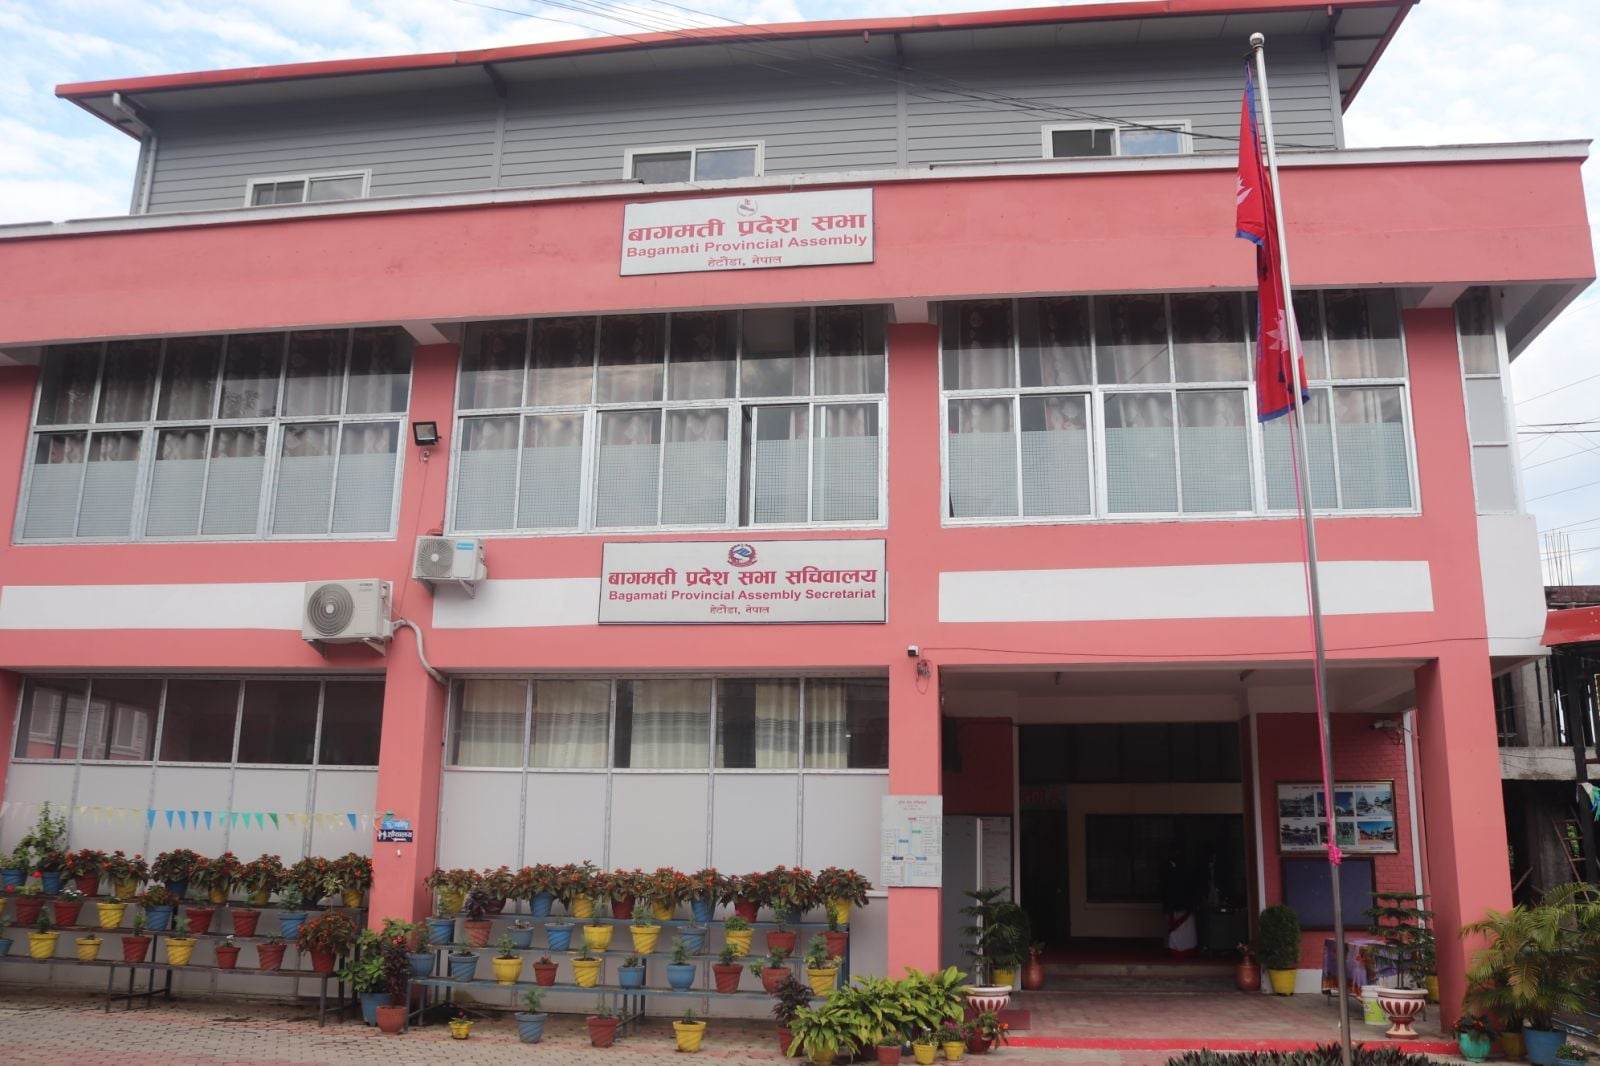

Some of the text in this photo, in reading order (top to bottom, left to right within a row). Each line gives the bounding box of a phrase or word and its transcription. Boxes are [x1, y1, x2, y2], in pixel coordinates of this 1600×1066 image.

[628, 214, 867, 242] बागमती प्रदेश सभा
[627, 234, 867, 258] Bagamati Provincial Assembly
[752, 254, 782, 265] नेपाल
[608, 566, 877, 586] बागमती प्रदेश सभा सचिवालय
[609, 589, 876, 602] Bagamati Provincial Assembly Secretariat
[745, 604, 770, 614] नेपाल
